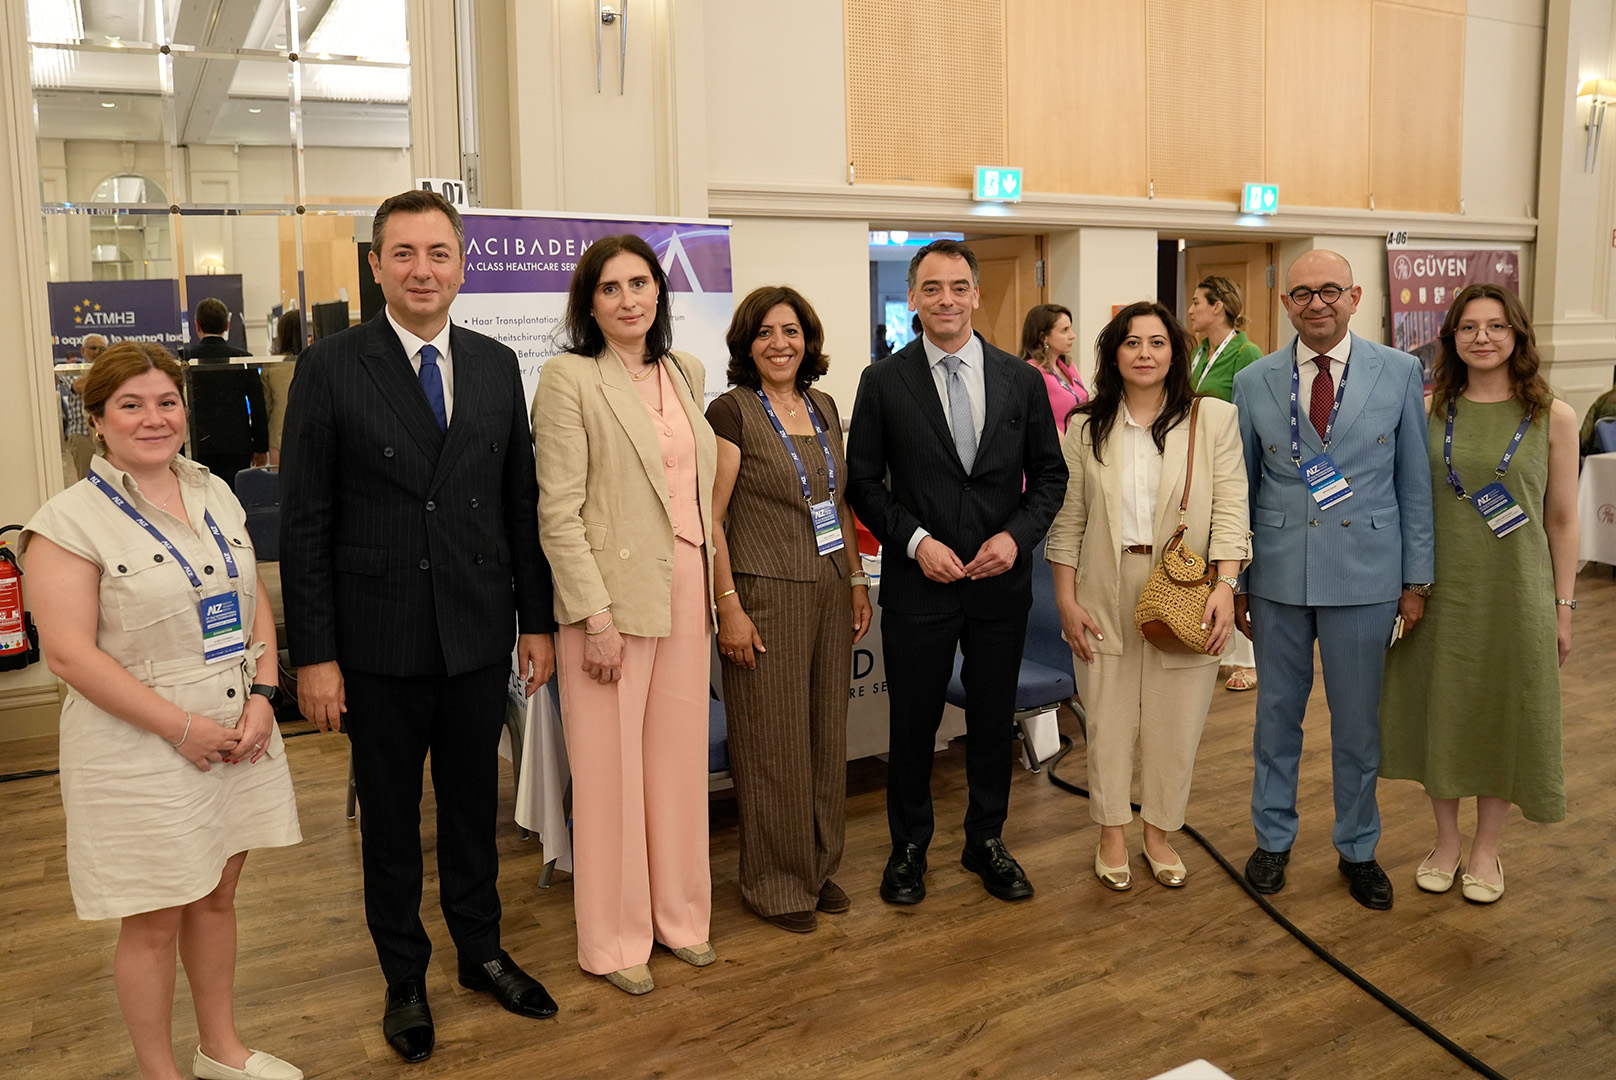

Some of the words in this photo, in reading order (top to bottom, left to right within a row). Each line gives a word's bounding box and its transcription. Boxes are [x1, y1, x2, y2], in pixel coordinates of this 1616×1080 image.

[1387, 232, 1407, 244] A-06
[476, 262, 504, 271] CLASS
[506, 262, 559, 271] HEALTHCARE
[1413, 254, 1467, 277] GÜVEN
[471, 317, 493, 326] Haar
[495, 315, 559, 326] Transplantation
